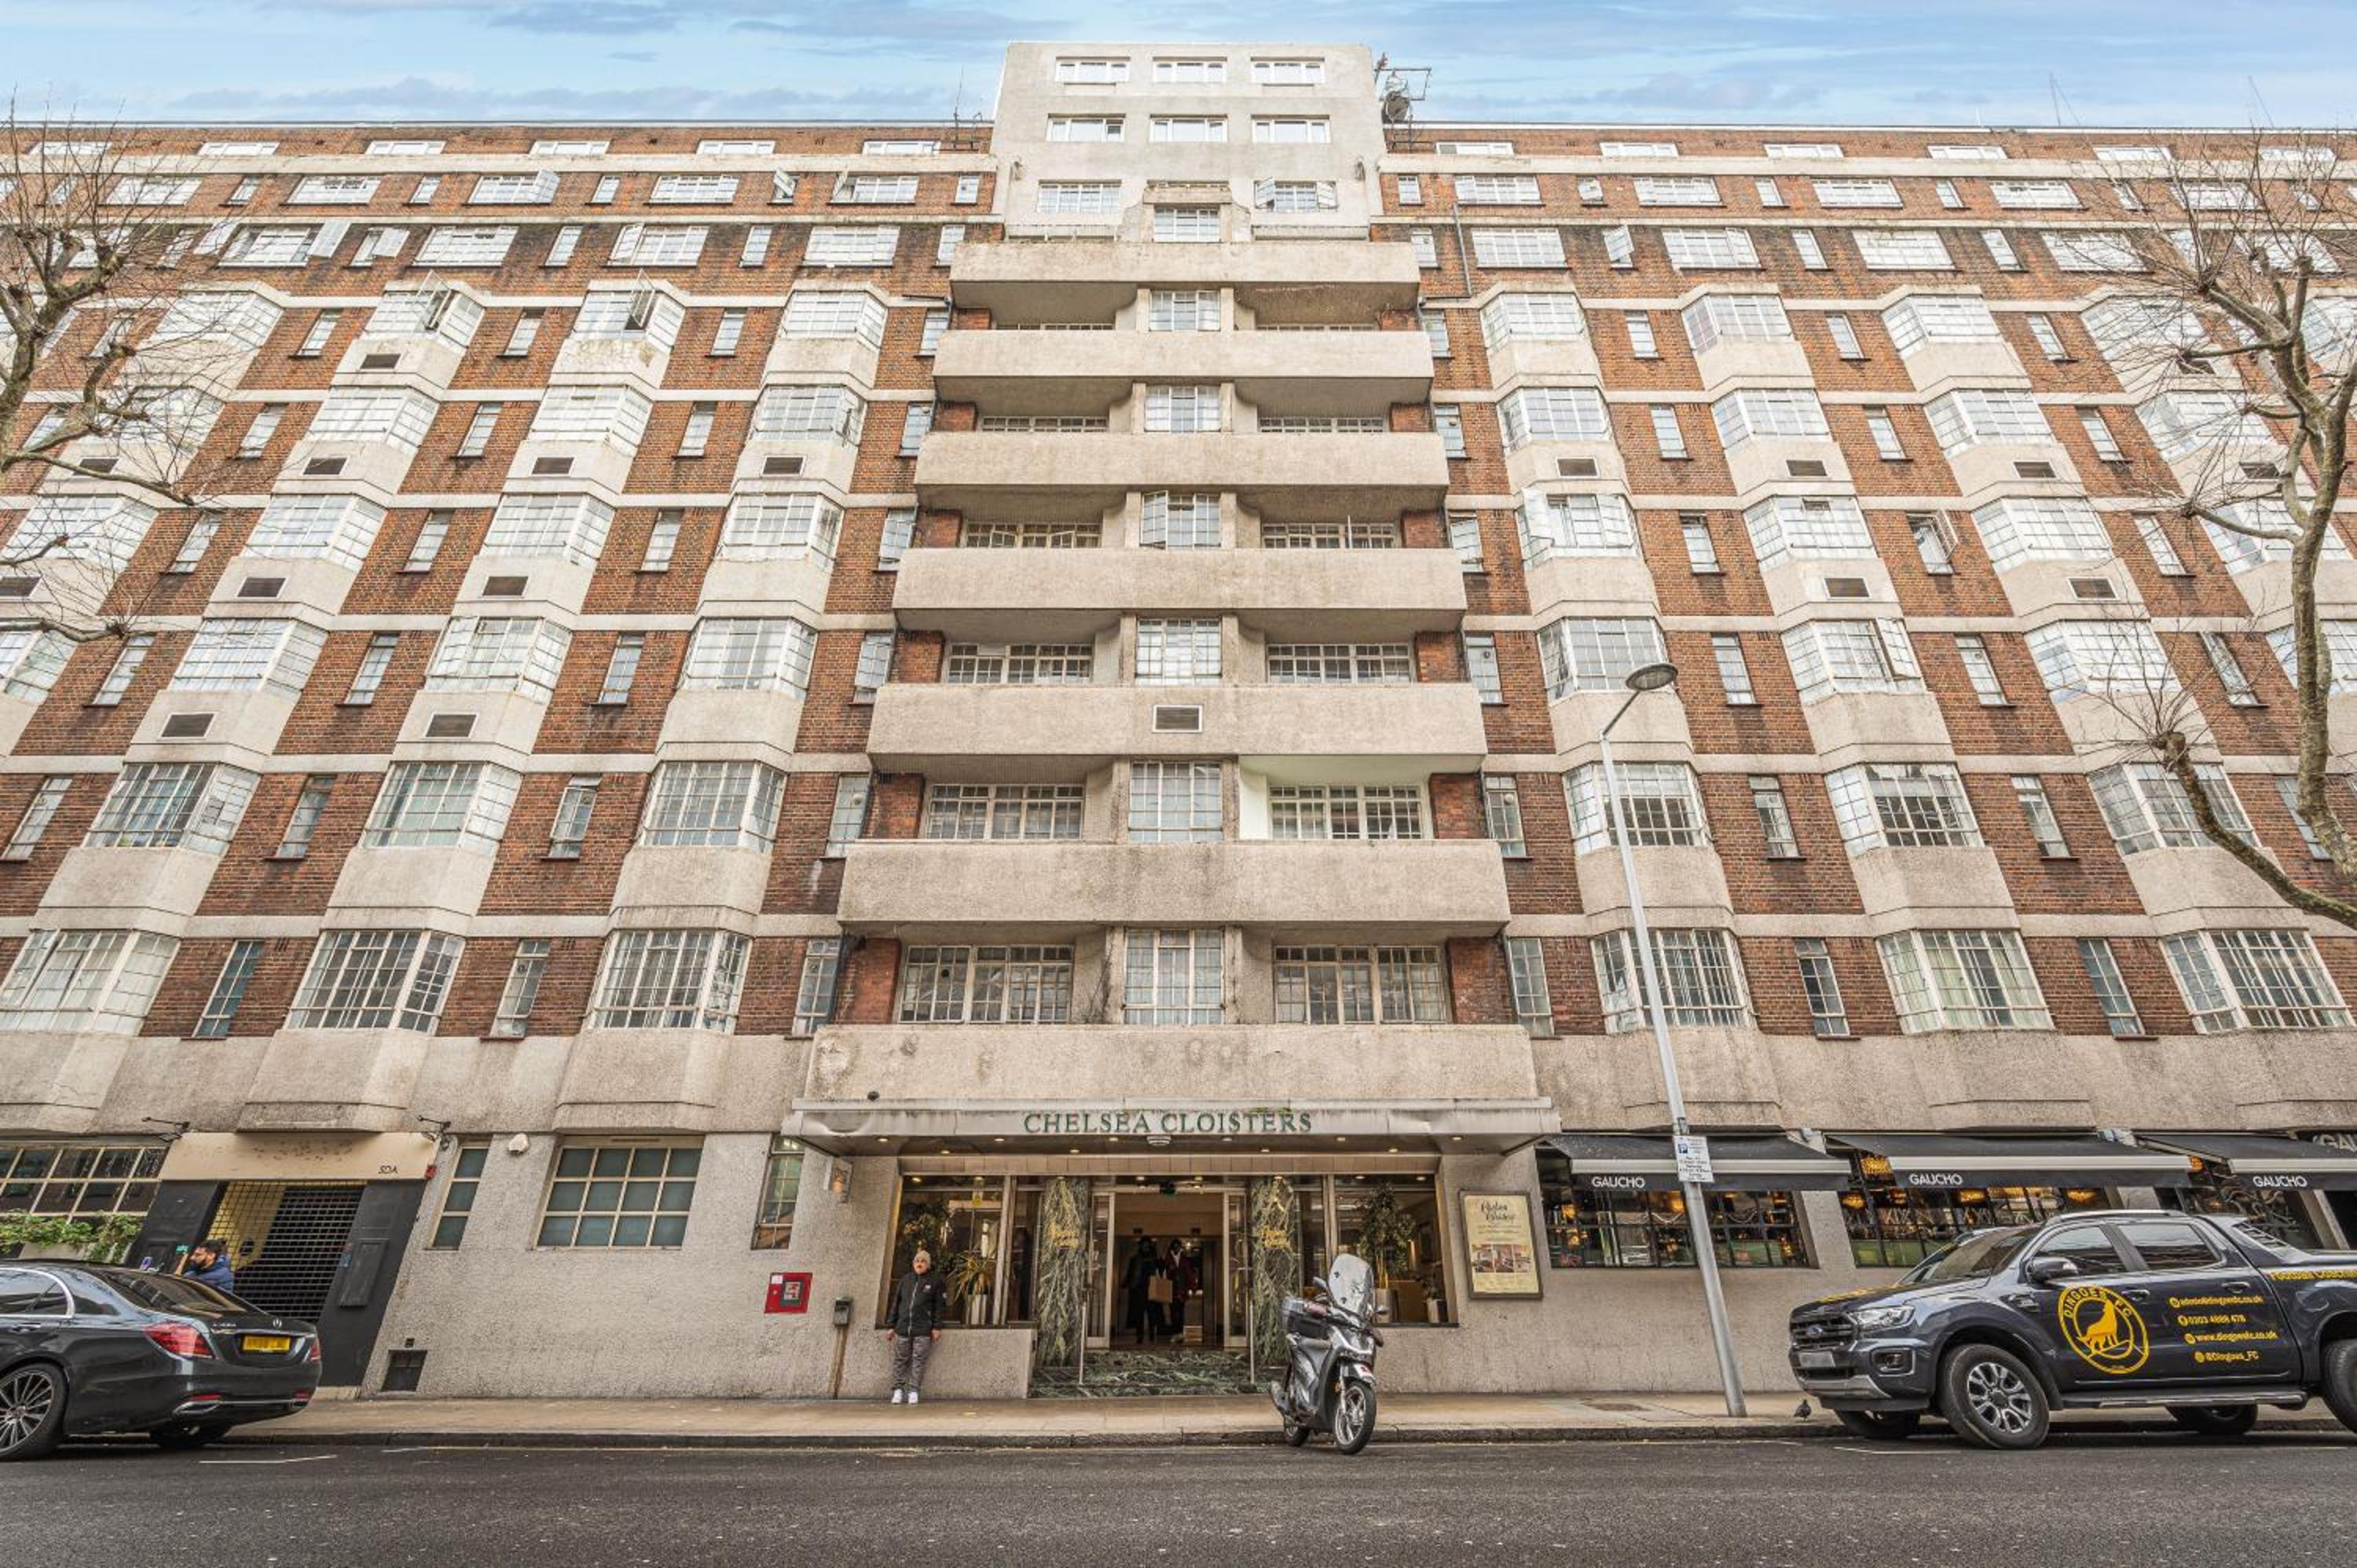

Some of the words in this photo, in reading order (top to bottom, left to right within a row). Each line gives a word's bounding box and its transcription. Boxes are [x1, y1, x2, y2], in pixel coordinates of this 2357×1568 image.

[1024, 1112, 1150, 1134] CHELSEA
[1160, 1112, 1312, 1134] CLOISTERS
[1592, 1176, 1645, 1188] GAUCHO
[1910, 1173, 1963, 1185] GAUCHO
[2253, 1175, 2308, 1187] GAUCHO
[2064, 1287, 2107, 1318] DINGOES
